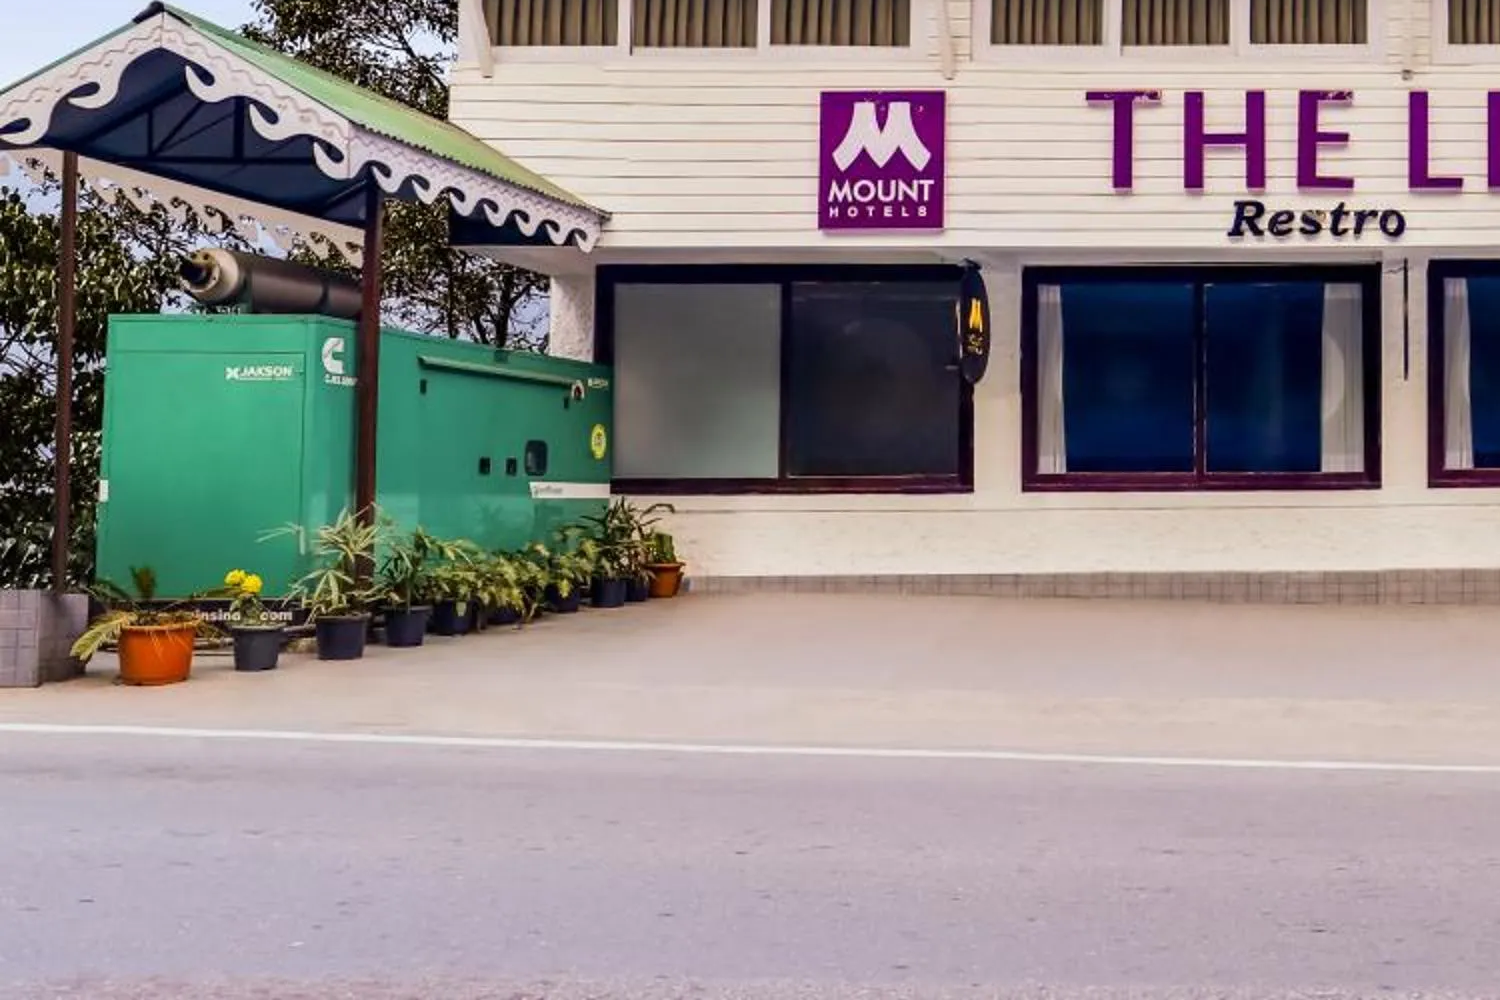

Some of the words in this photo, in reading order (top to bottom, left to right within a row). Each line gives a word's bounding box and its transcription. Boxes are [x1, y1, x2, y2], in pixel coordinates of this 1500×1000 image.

[1086, 90, 1354, 188] THE
[828, 179, 935, 202] MOUNT
[828, 206, 928, 218] HOTELS
[1227, 199, 1407, 238] Restro
